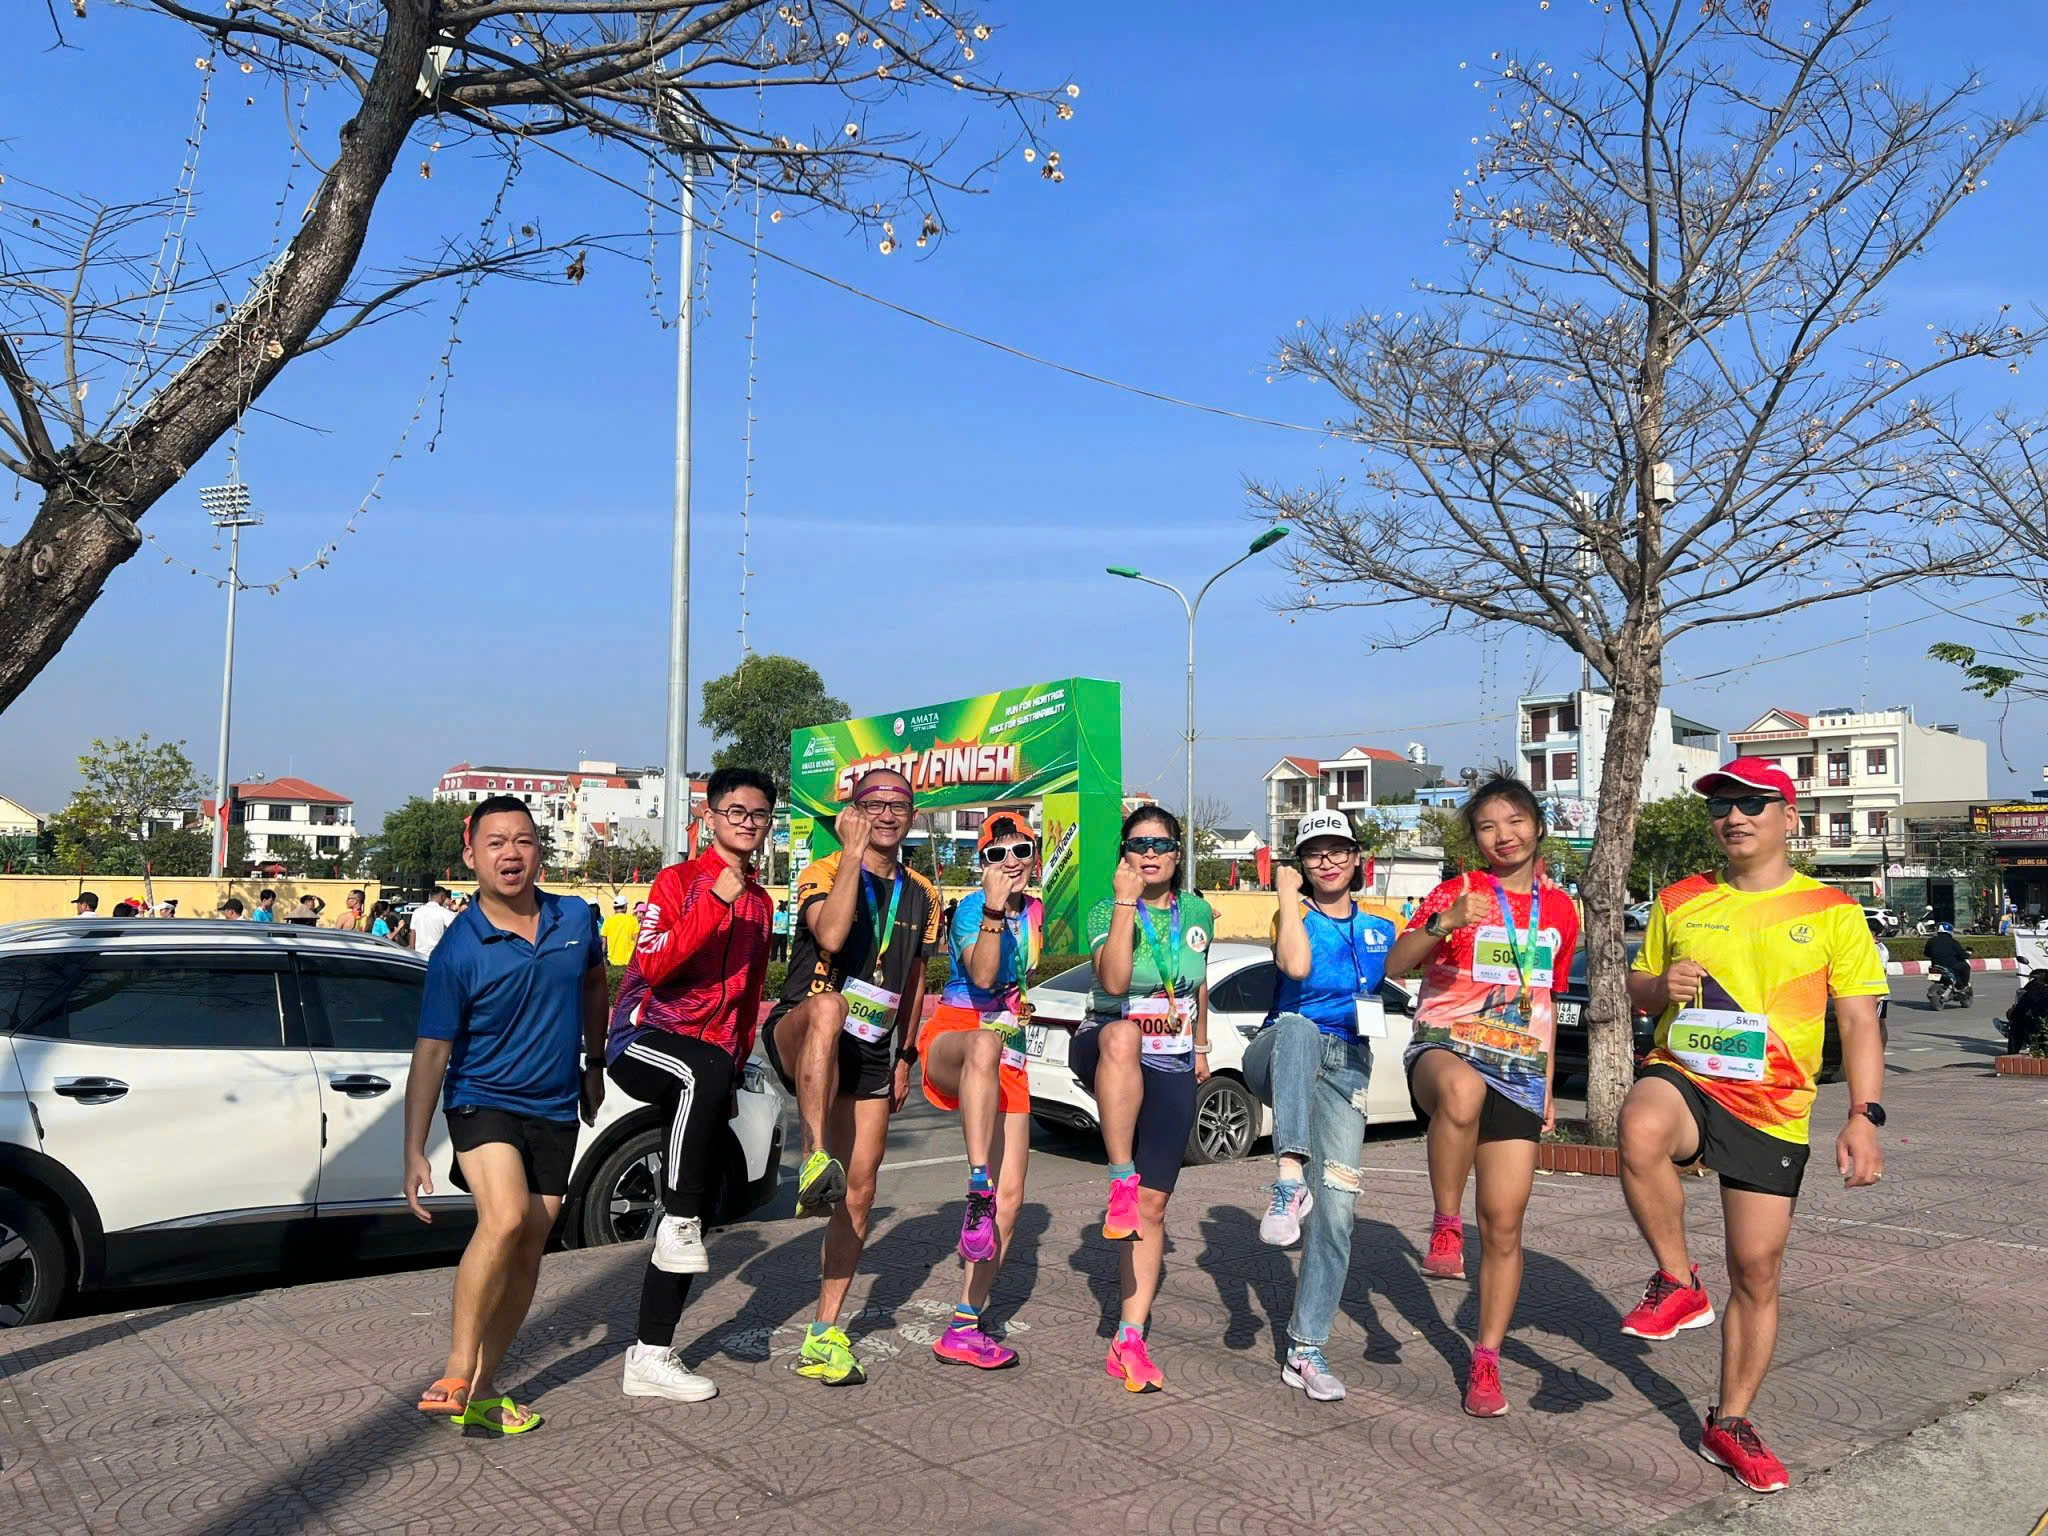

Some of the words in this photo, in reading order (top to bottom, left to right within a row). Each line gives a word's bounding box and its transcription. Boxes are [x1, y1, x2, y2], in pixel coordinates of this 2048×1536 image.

[1006, 704, 1019, 717] RUN
[1020, 700, 1032, 711] FOR
[1033, 688, 1064, 707] HERITAGE
[910, 712, 940, 725] AMATA
[1005, 719, 1017, 730] FOR
[1017, 702, 1066, 726] SUSTAINABILITY
[1686, 922, 1703, 930] Cam
[1704, 923, 1730, 931] Hoang
[1736, 1016, 1759, 1026] 5km
[1688, 1033, 1748, 1053] 50626
